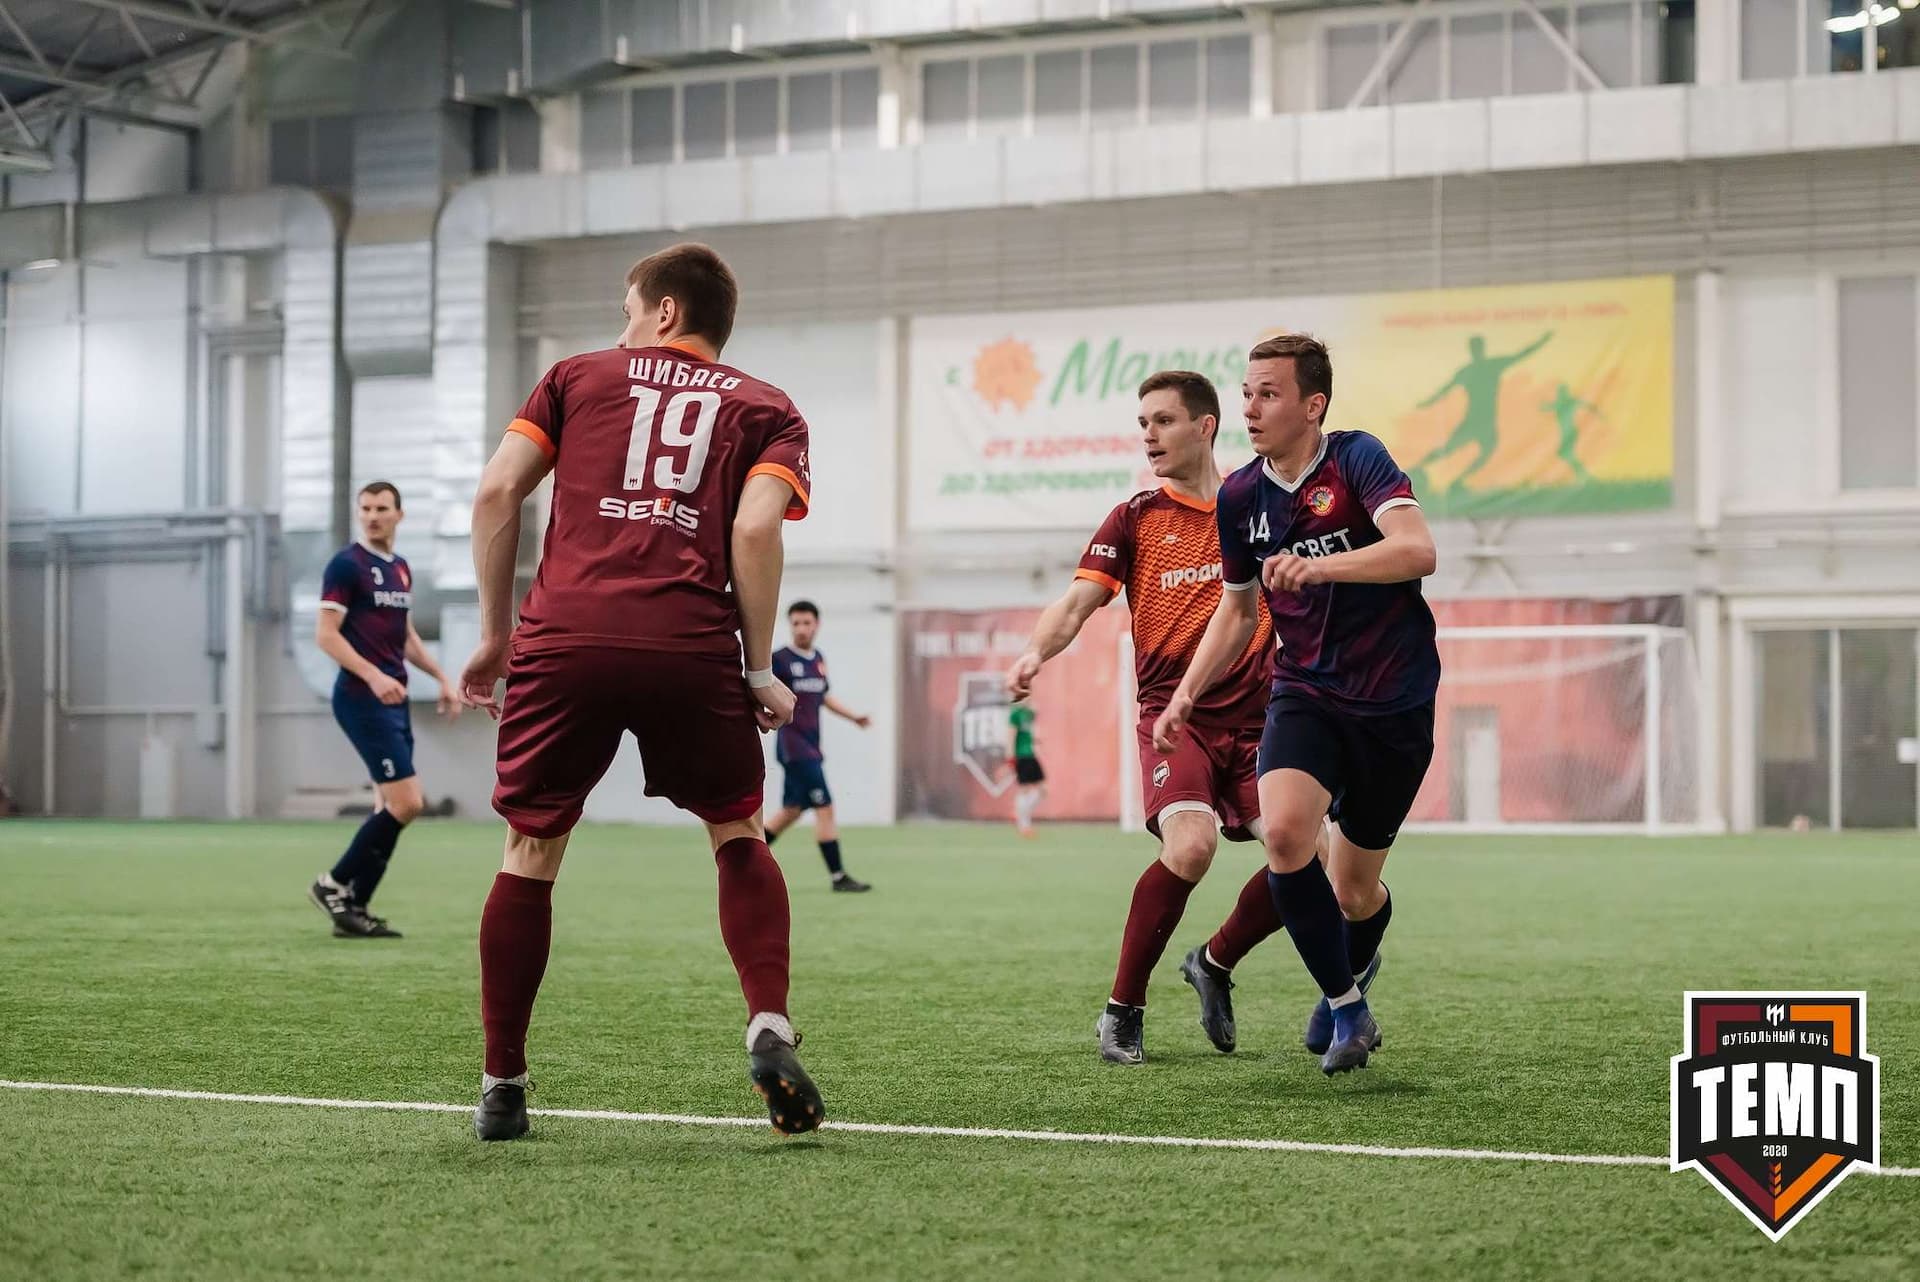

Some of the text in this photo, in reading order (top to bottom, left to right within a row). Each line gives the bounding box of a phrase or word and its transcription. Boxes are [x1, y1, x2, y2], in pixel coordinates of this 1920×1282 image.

[628, 357, 743, 391] ШИБАЕВ
[623, 384, 722, 494] 19
[599, 496, 700, 530] SEUS
[1249, 511, 1271, 544] 14
[370, 566, 384, 586] 3
[1160, 561, 1223, 591] ПРОДИ
[381, 758, 396, 779] 3
